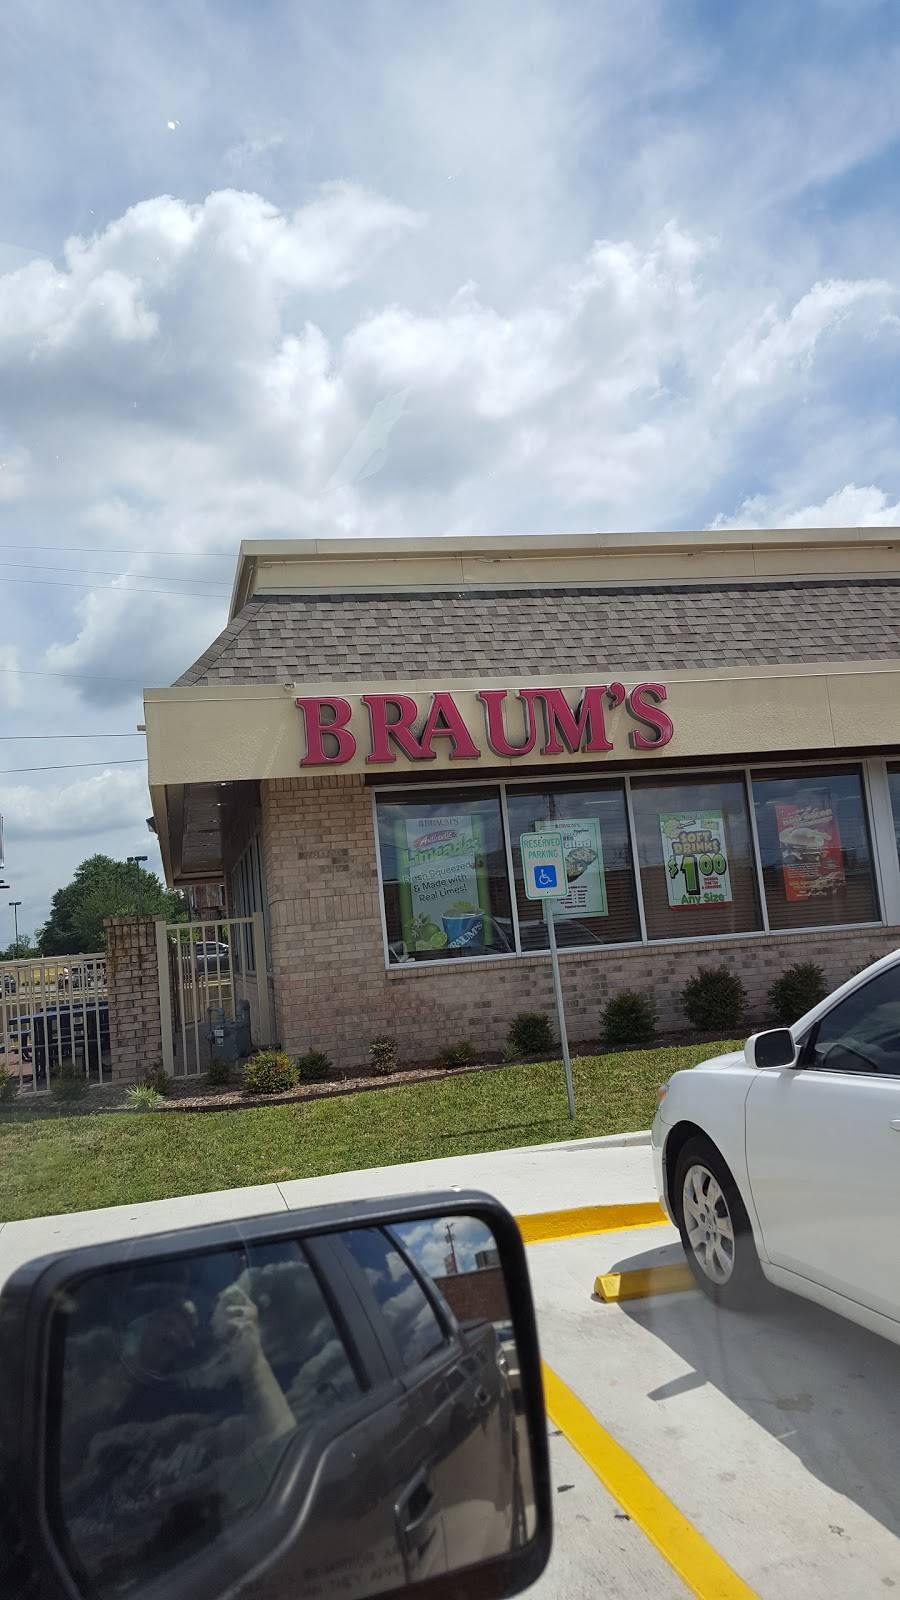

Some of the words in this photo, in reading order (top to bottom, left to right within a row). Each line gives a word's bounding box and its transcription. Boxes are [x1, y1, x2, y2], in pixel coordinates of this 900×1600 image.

[296, 681, 674, 766] BRAUM'S
[522, 838, 560, 849] RESERVED
[680, 831, 711, 843] SOFT
[673, 840, 720, 854] DRINKS
[528, 850, 558, 859] PARKING
[422, 879, 446, 891] Made
[448, 873, 467, 884] with
[419, 890, 438, 902] Real
[439, 883, 467, 897] Limes!
[681, 894, 700, 906] Any
[703, 892, 725, 903] Size
